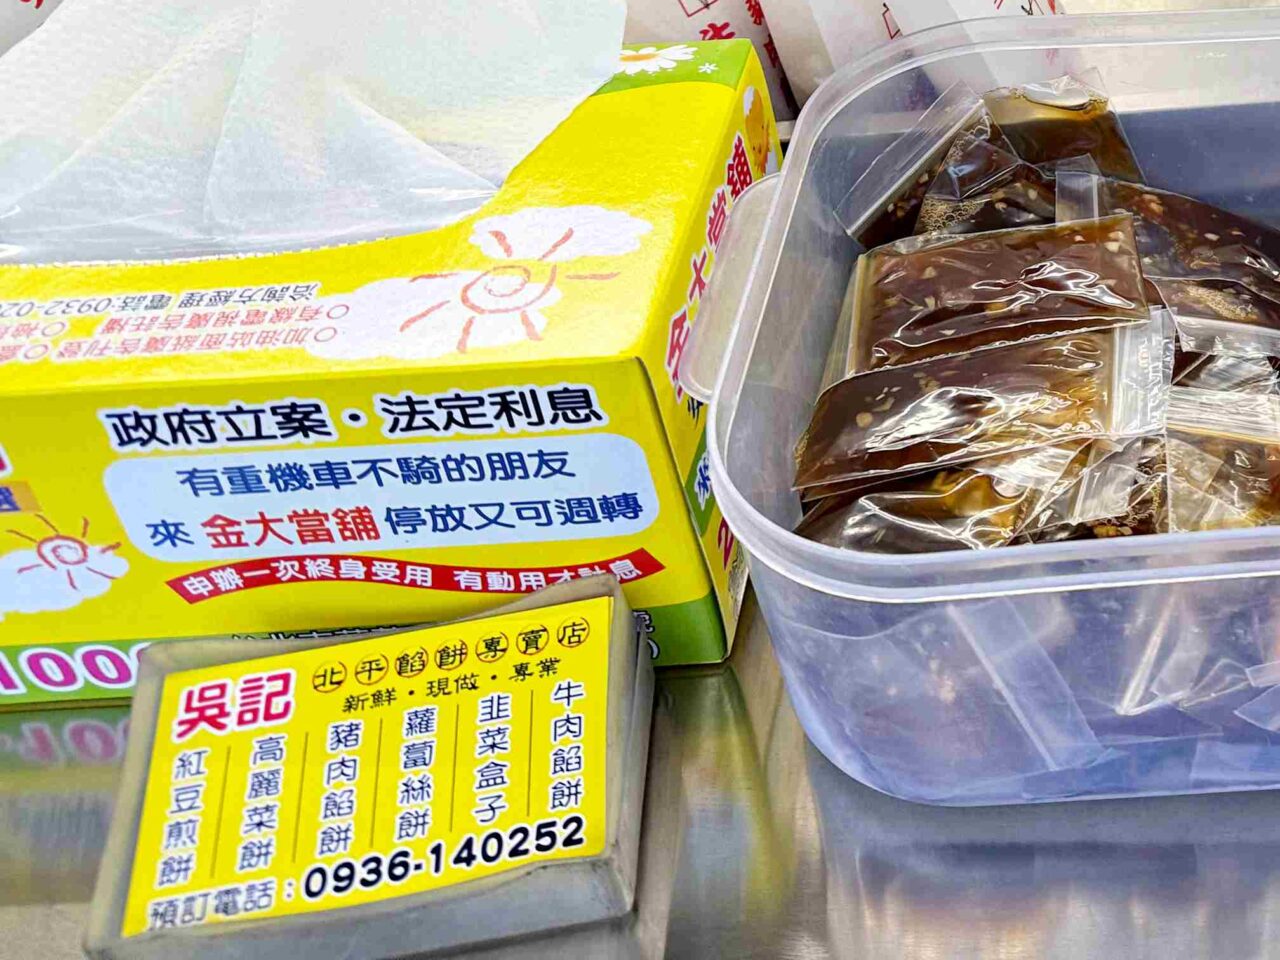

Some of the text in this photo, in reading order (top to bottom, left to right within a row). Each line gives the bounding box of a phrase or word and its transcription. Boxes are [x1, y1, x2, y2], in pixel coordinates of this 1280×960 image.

[178, 283, 319, 309] 洽詢方經理
[177, 449, 576, 497] 有重機車不騎的朋友
[146, 492, 642, 549] 來 金大當舖 停放又可週轉
[184, 556, 433, 598] 申辦一次終身受用
[314, 617, 590, 692] 北平餡餅專賣店
[176, 672, 293, 739] 吳記
[551, 680, 586, 811] 牛肉餡餅
[318, 722, 364, 856] 豬肉餡餅
[397, 707, 437, 840] 蘿蔔絲餅
[472, 693, 511, 824] 韭菜盒子
[157, 749, 209, 887] 紅豆煎餅
[239, 736, 287, 872] 高麗菜餅
[303, 815, 585, 899] 0936-140252
